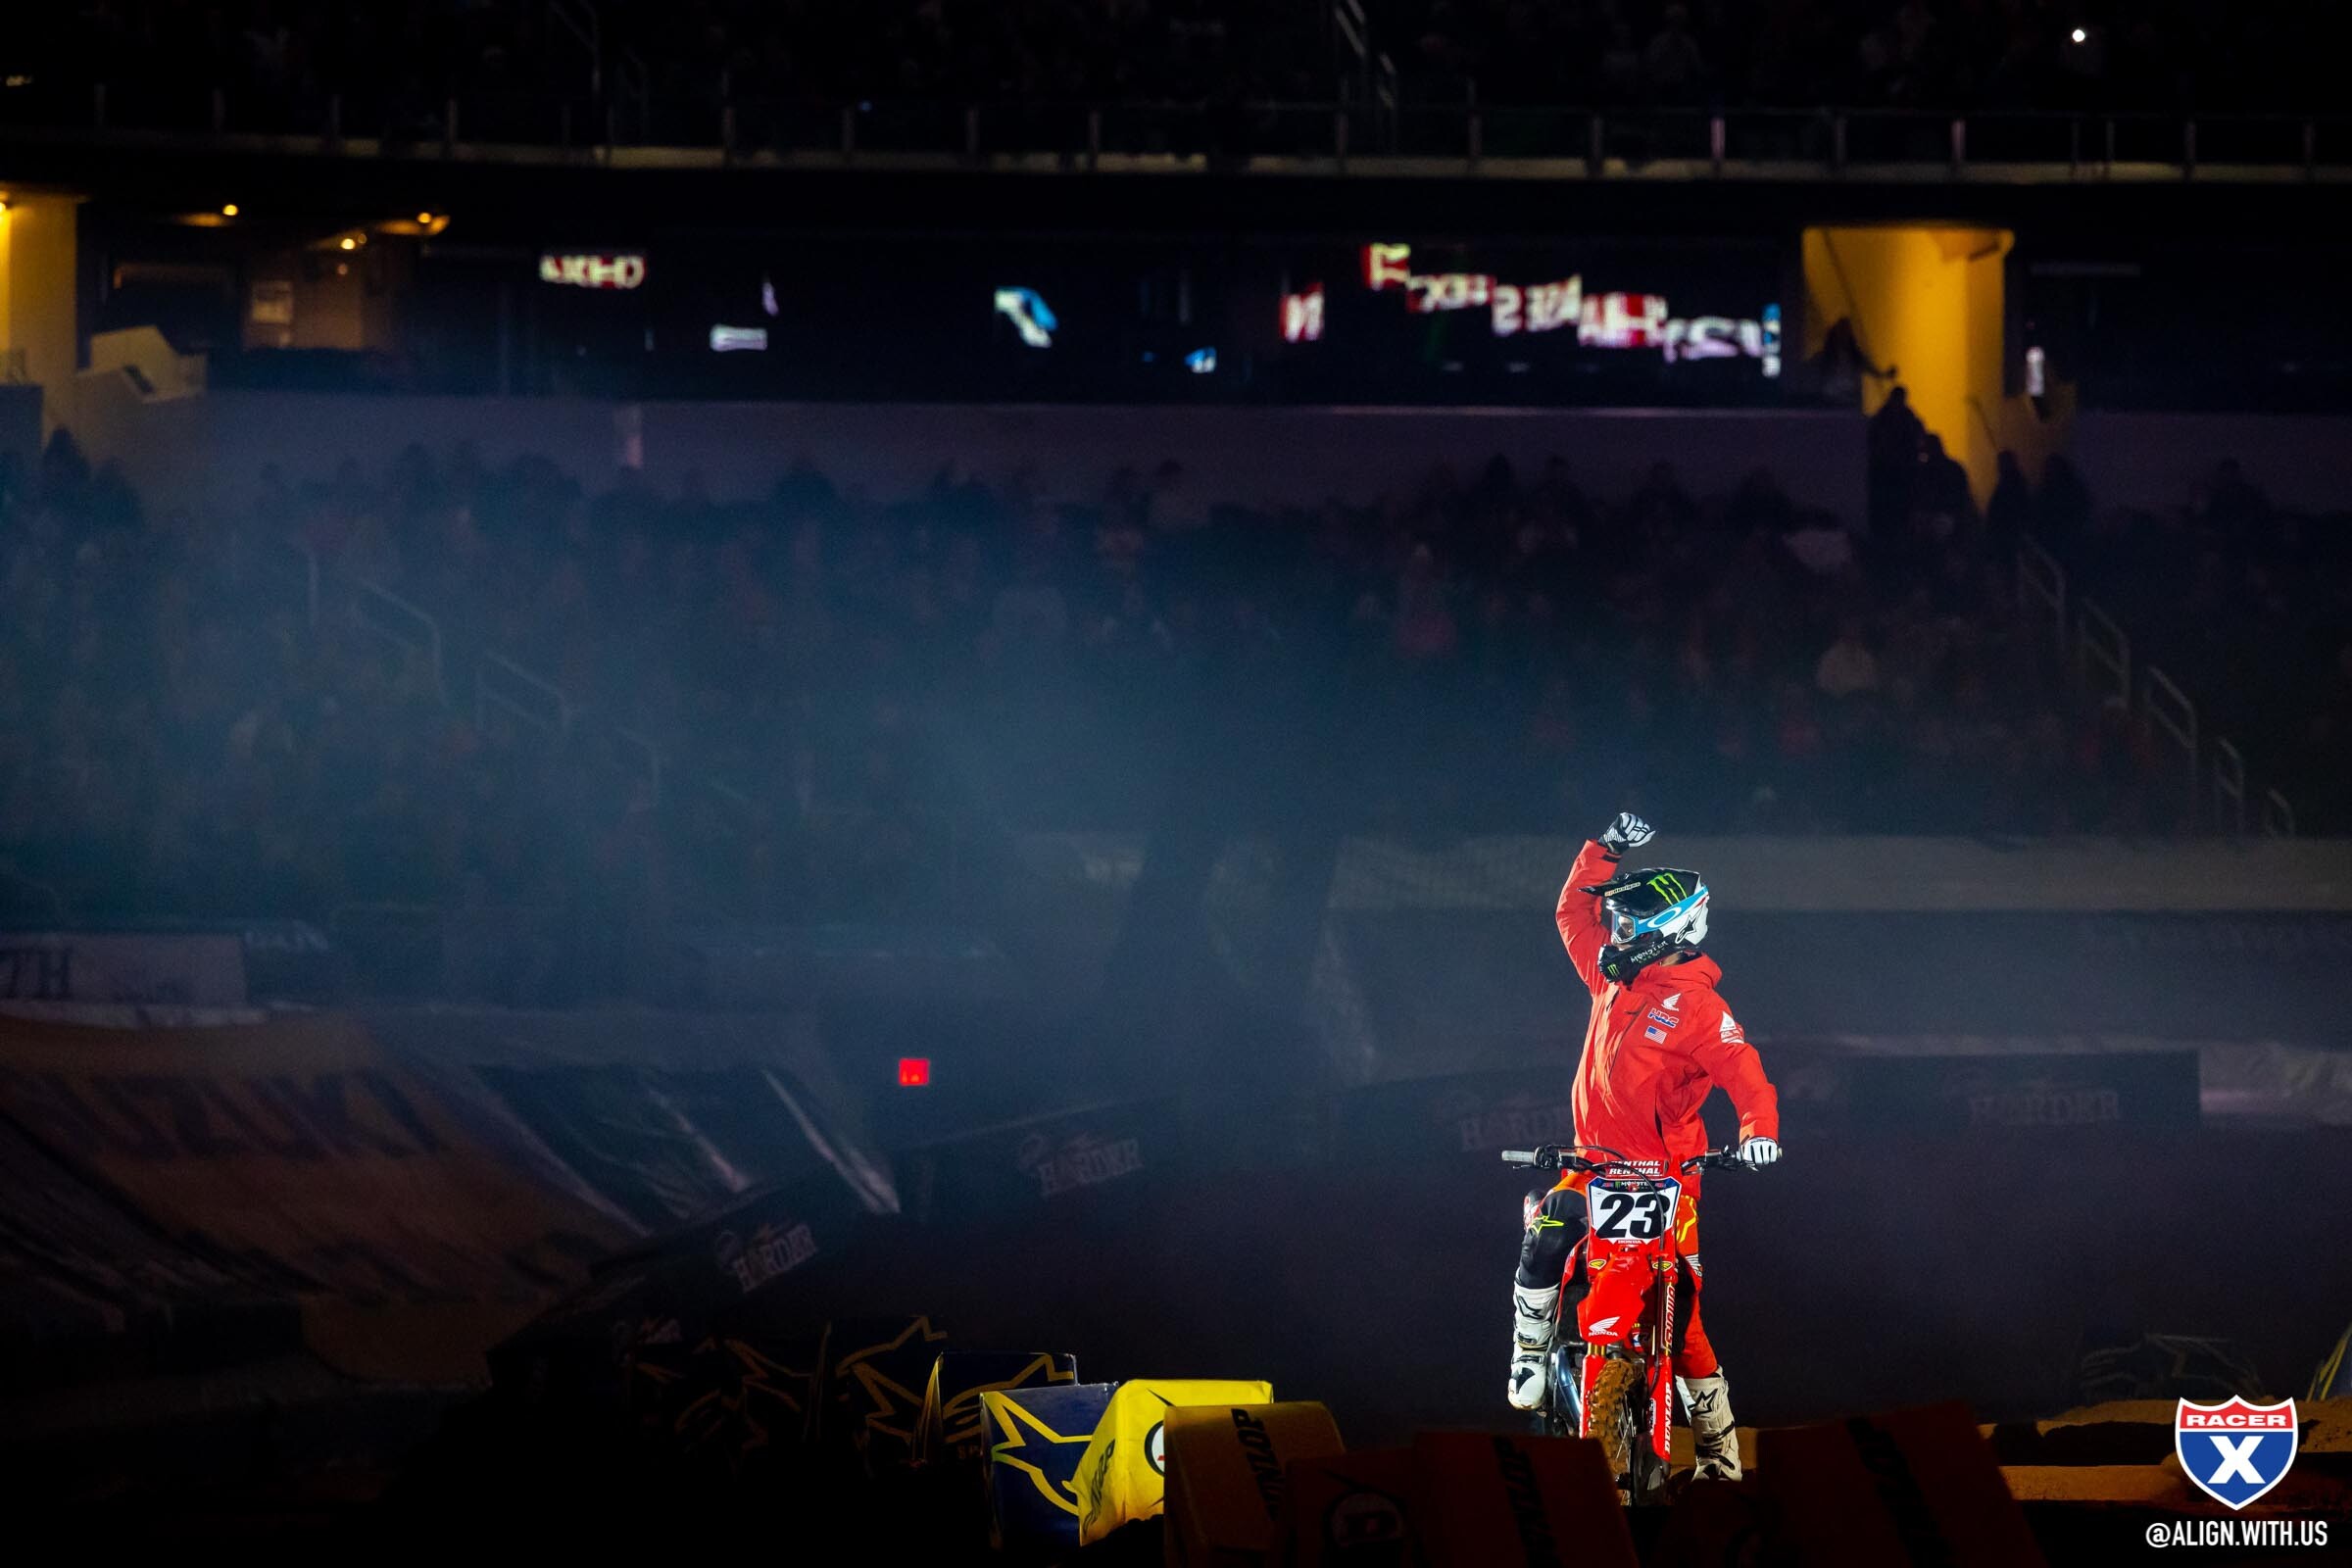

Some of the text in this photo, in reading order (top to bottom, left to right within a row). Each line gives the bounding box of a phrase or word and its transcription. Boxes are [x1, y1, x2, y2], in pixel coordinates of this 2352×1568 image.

[1647, 1007, 1680, 1029] HRC
[1609, 1167, 1662, 1176] RENHAL
[1595, 1193, 1671, 1240] 23
